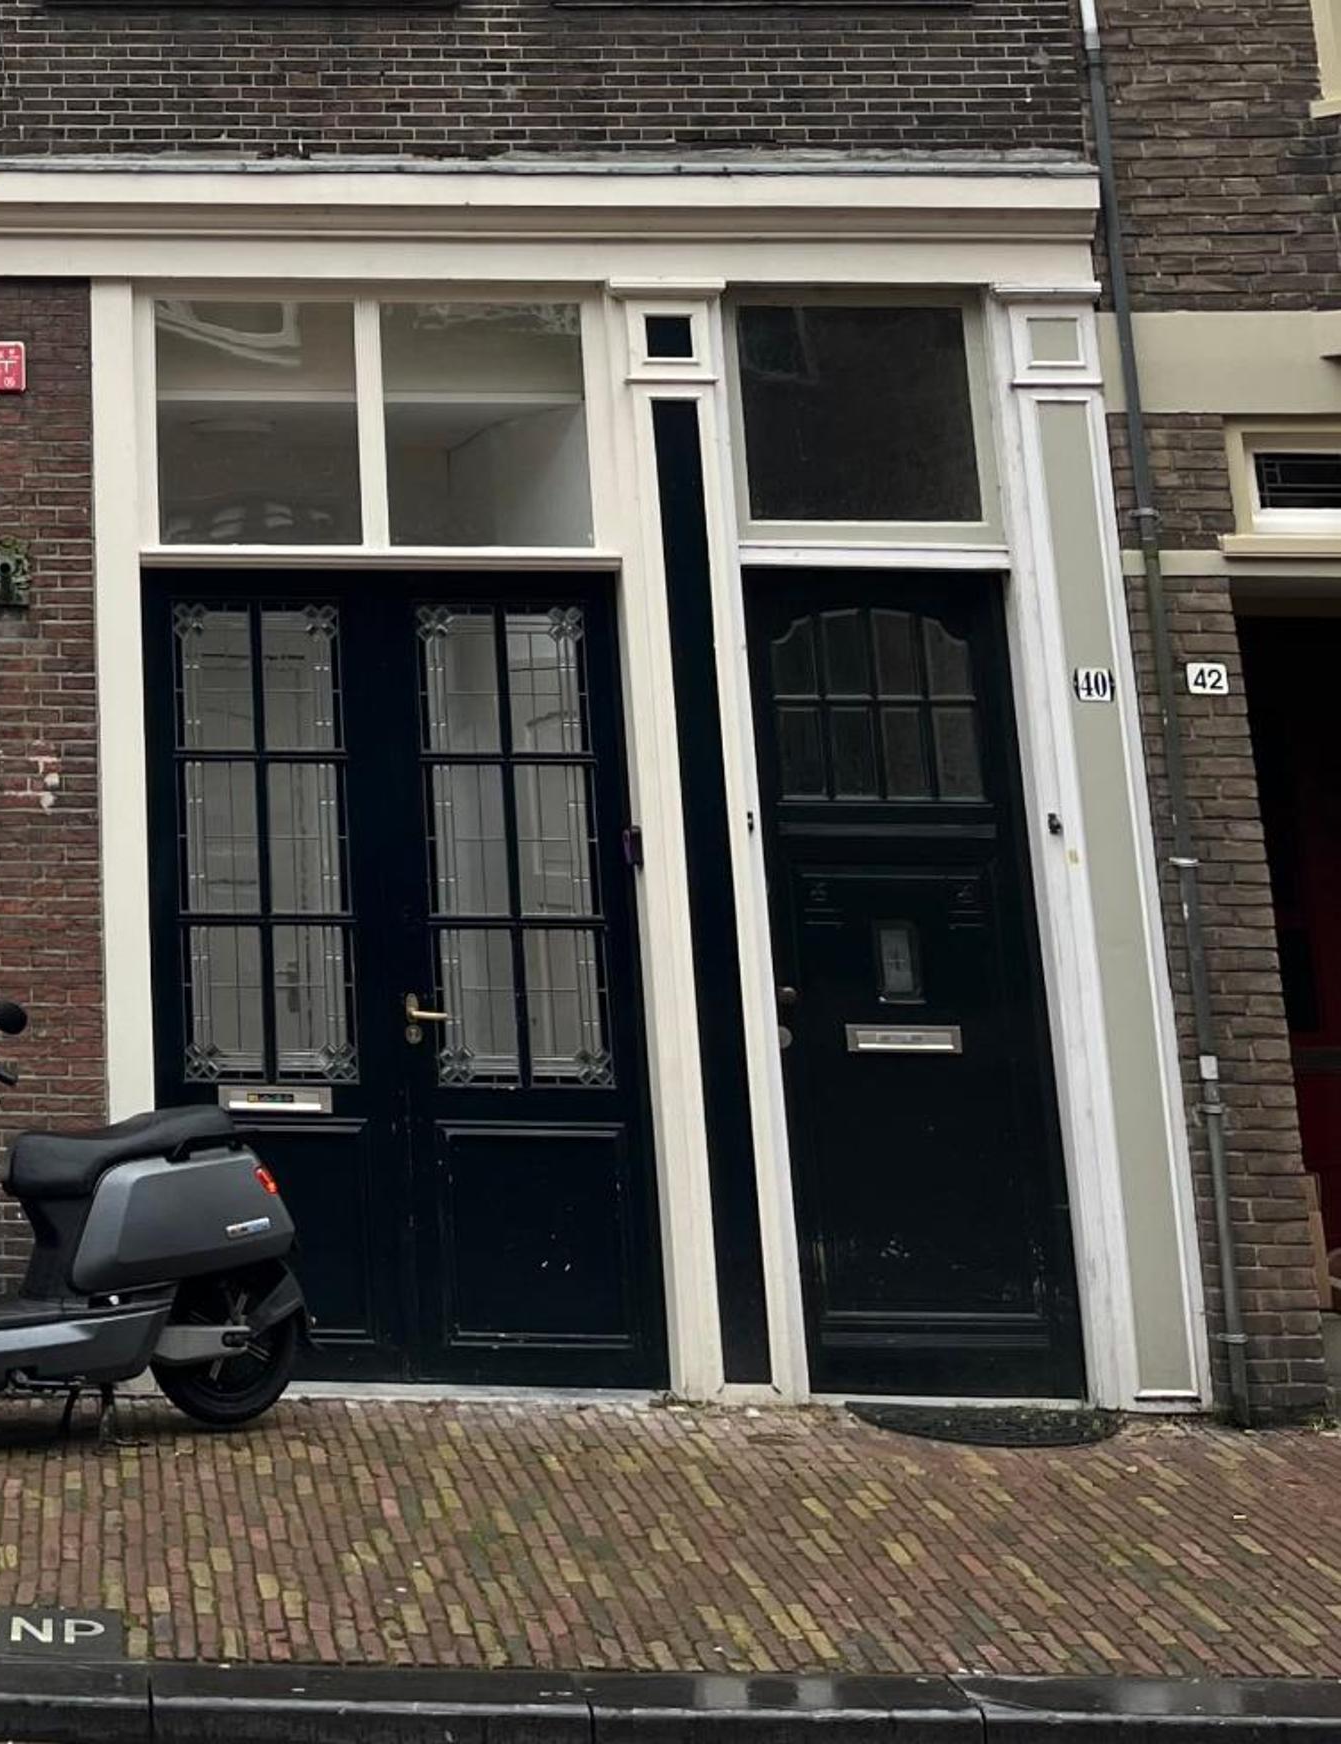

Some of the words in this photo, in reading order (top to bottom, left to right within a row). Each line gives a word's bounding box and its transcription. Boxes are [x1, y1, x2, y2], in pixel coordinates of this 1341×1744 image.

[1080, 671, 1108, 697] 40
[1193, 668, 1224, 690] 42
[10, 1616, 106, 1645] NP
